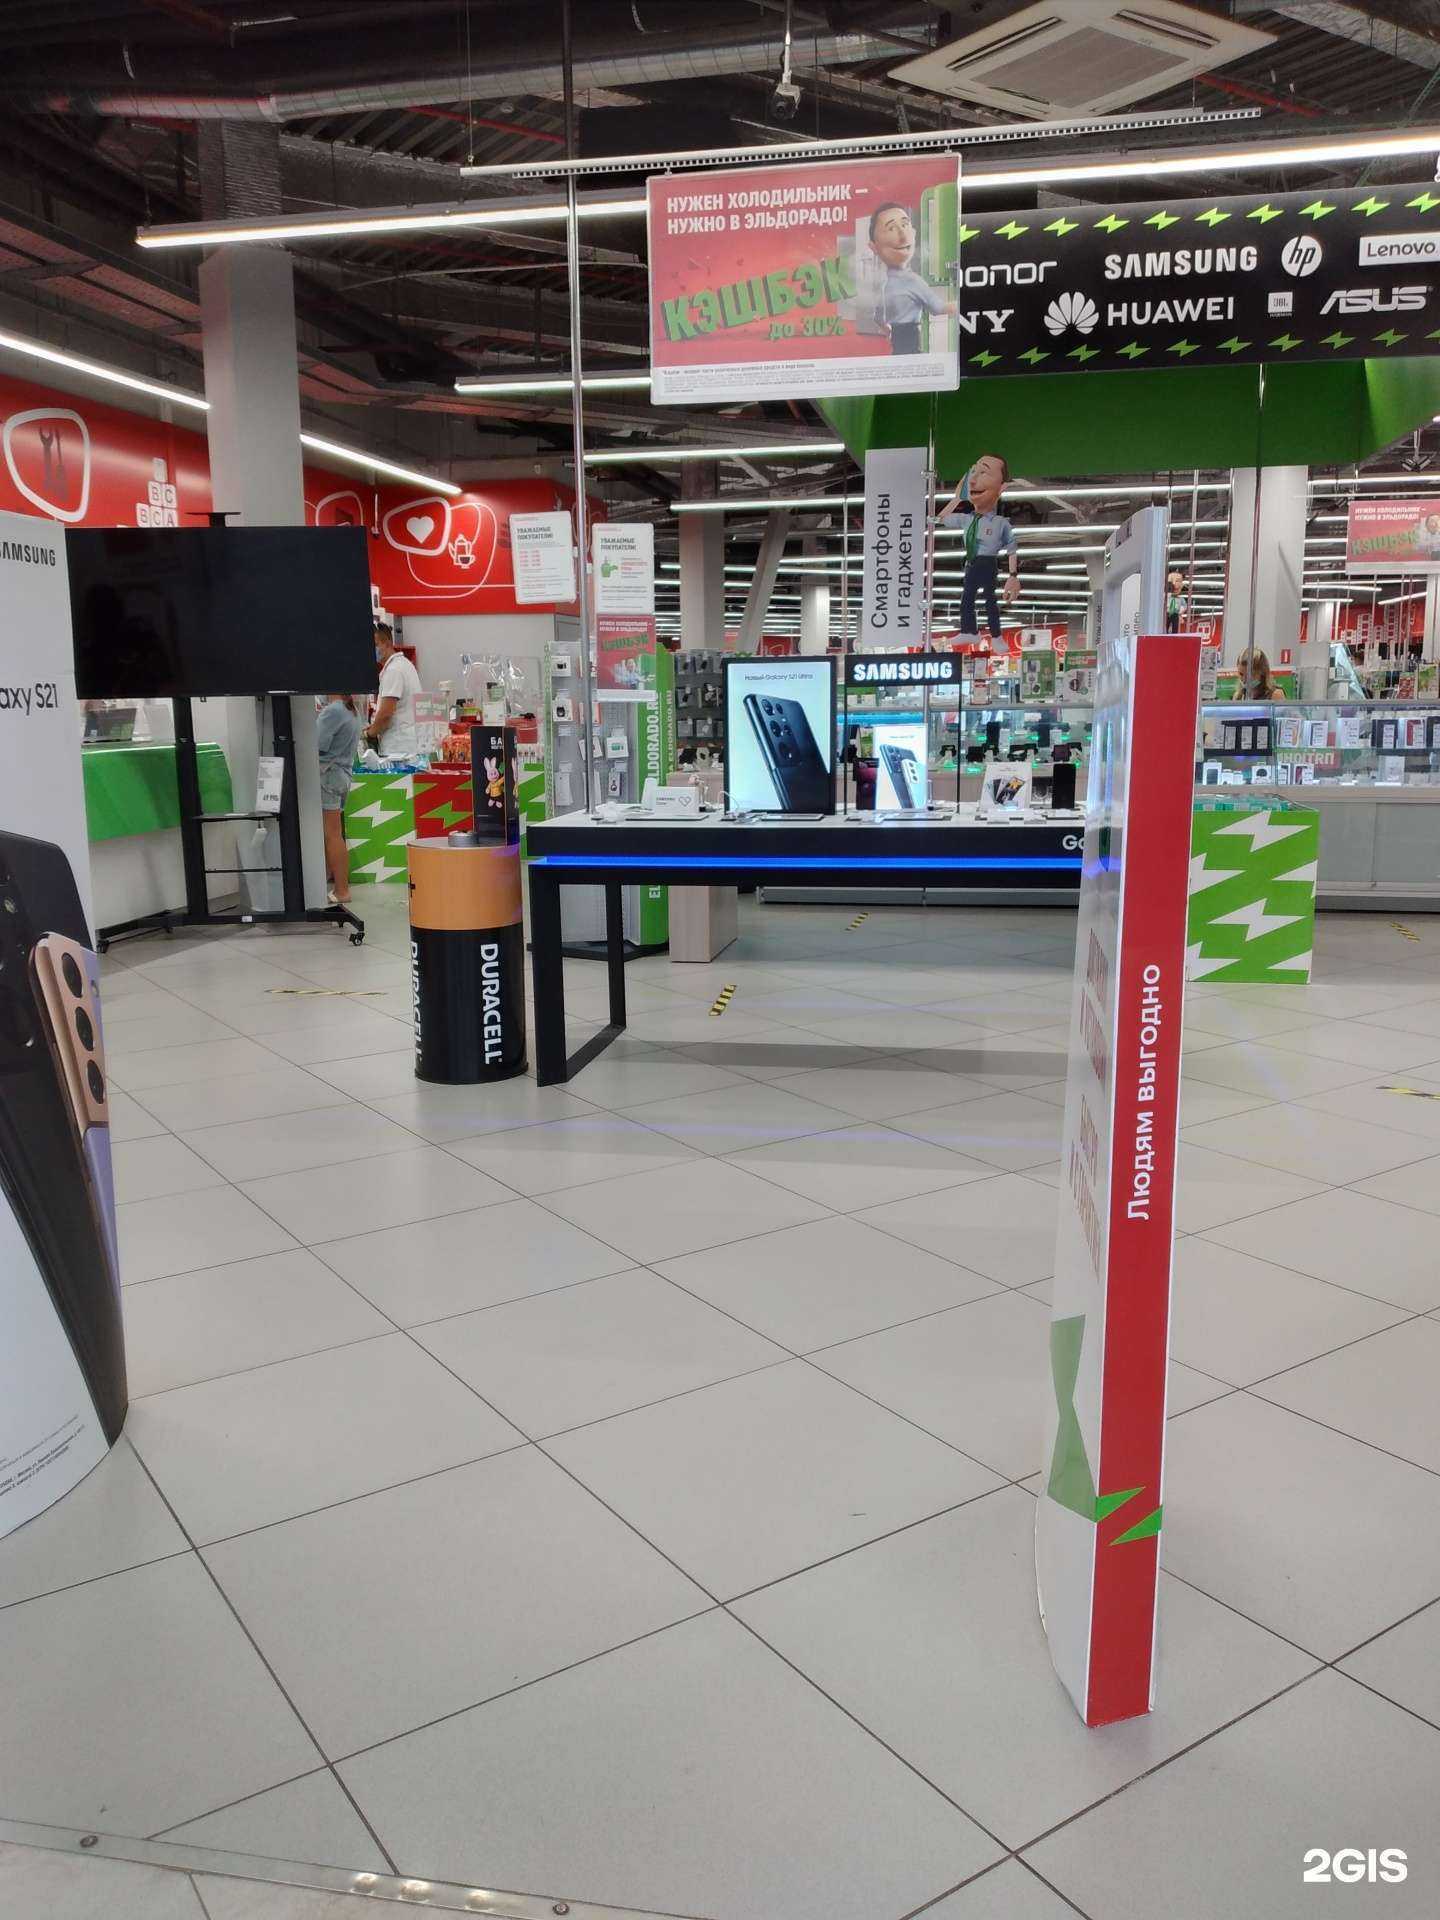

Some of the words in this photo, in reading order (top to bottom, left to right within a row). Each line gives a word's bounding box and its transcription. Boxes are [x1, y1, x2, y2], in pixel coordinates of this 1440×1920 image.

[667, 194, 723, 214] НУЖЕН
[728, 184, 852, 210] ХОЛОДИЛЬНИК
[667, 215, 725, 234] НУЖНО
[730, 213, 741, 231] В
[744, 206, 848, 229] ЭЛЬДОРАДО!
[1104, 245, 1257, 280] SAMSUNG
[1287, 235, 1317, 278] hp
[1367, 241, 1436, 257] Lenovo
[661, 254, 858, 342] КЭШБЭК
[1107, 296, 1234, 327] HUAWEI
[1319, 285, 1428, 315] ASUS
[801, 315, 846, 338] 30%
[870, 493, 893, 629] Смартфоны
[897, 513, 914, 609] гаджеты
[896, 620, 910, 628] и
[853, 662, 953, 681] SAMSUNG
[35, 683, 58, 709] S21
[480, 943, 503, 1065] DURACELL
[1138, 964, 1162, 1102] выгодно
[1127, 1111, 1155, 1221] Людям
